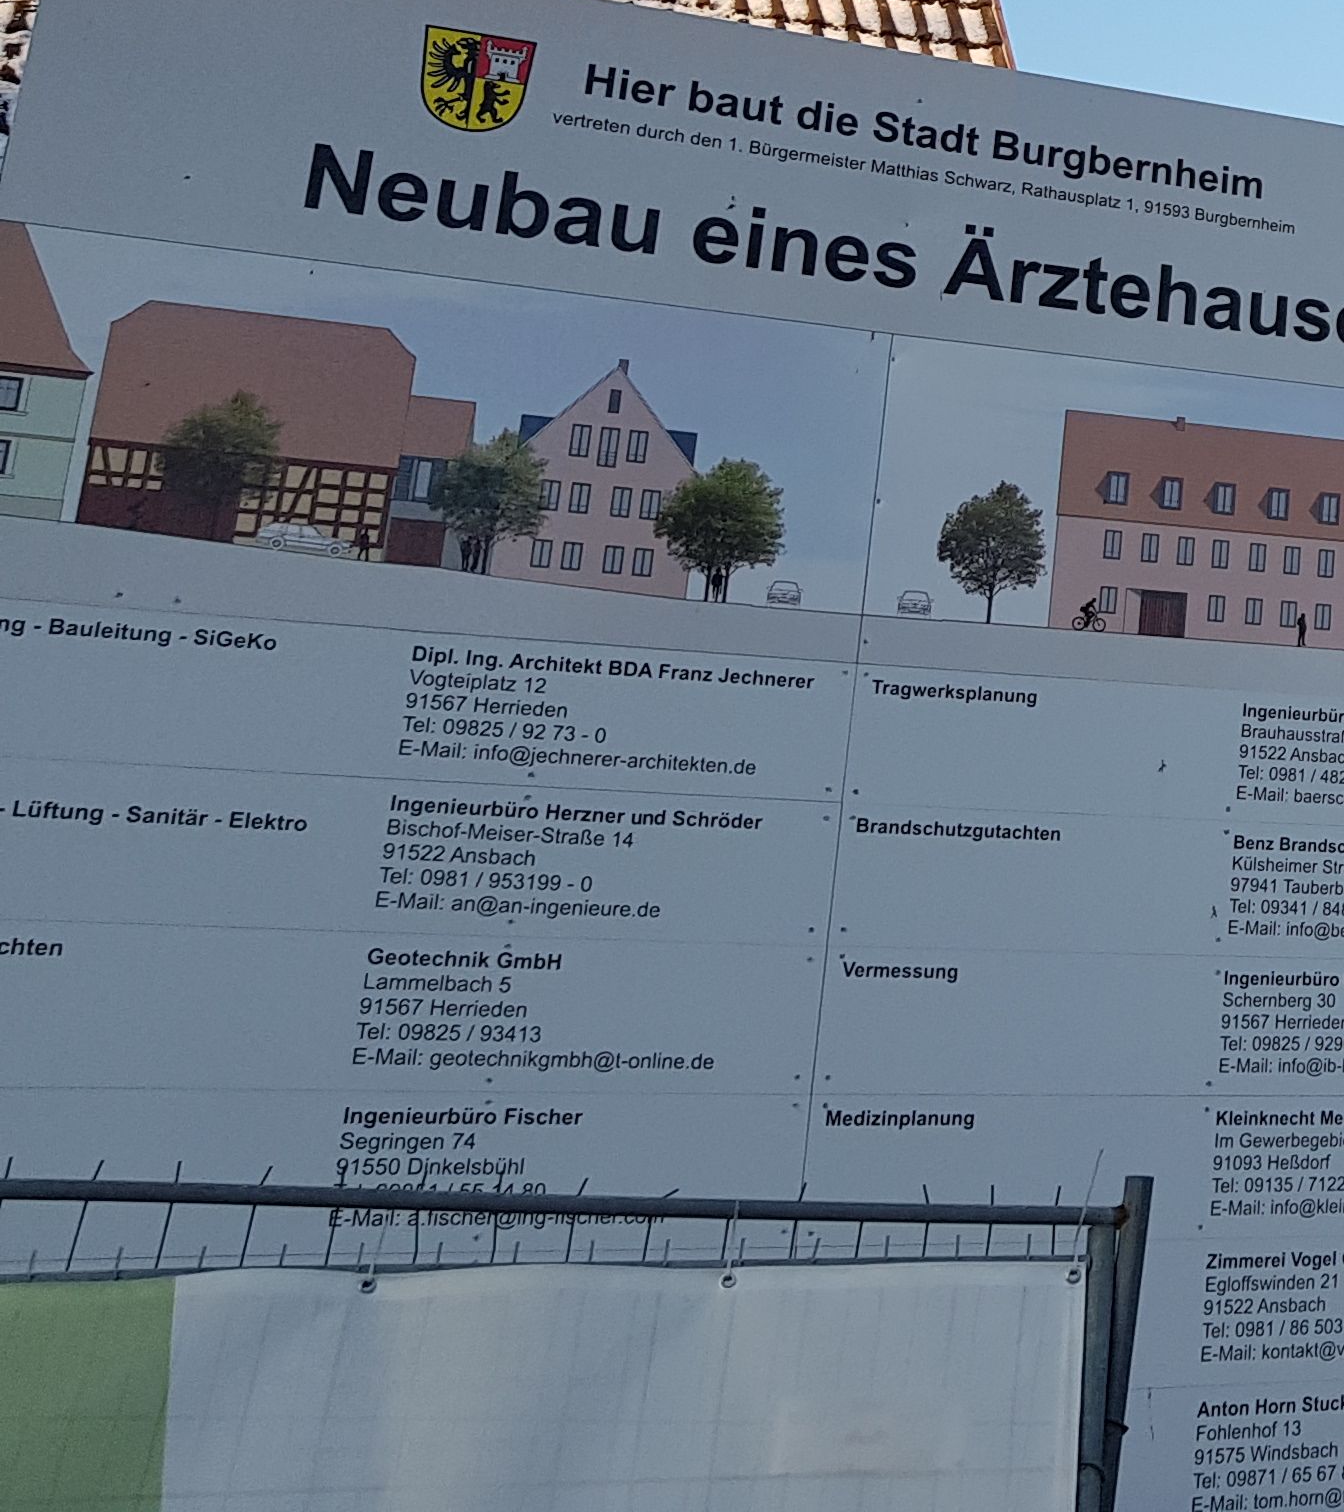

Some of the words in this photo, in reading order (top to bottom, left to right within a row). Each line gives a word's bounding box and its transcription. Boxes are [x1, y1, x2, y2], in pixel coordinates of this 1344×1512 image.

[585, 64, 676, 106] Hier
[688, 80, 783, 125] baut
[797, 101, 858, 136] die
[873, 112, 979, 156] Stadt
[992, 130, 1262, 199] Burgbernheim
[553, 113, 630, 135] vertreten
[637, 123, 684, 143] durch
[690, 132, 722, 149] den
[749, 140, 867, 170] Bürgermeister
[871, 159, 938, 182] Matthias
[945, 171, 1015, 195] Schwarz,
[1022, 182, 1121, 209] Rathausplatz
[1144, 200, 1189, 219] 91593
[1195, 208, 1295, 234] Burgbernheim
[304, 143, 660, 255] Neubau
[693, 207, 916, 288] eines
[48, 618, 172, 647] Bauleitung
[194, 629, 276, 650] SiGeKo
[412, 646, 458, 666] Dipl.
[466, 650, 503, 671] Ing.
[508, 654, 602, 674] Architekt
[609, 660, 653, 678] BDA
[658, 664, 713, 682] Franz
[718, 668, 815, 689] Jechnerer
[410, 669, 517, 693] Vogteiplatz
[524, 677, 546, 694] 12
[872, 679, 1037, 707] Tragwerksplanung
[406, 693, 468, 712] 91567
[474, 697, 567, 718] Herrieden
[398, 739, 467, 759] E-Mail:
[474, 744, 756, 775] info@jechnerer-architekten.de
[1240, 744, 1286, 760] 91522
[1238, 764, 1263, 780] Tel:
[1269, 767, 1304, 782] 0981
[1237, 785, 1288, 802] E-Mail:
[12, 800, 104, 825] Lüftung
[126, 806, 209, 826] Sanitär
[229, 811, 307, 831] Elektro
[390, 795, 538, 819] Ingenieurbüro
[546, 804, 626, 824] Herzner
[631, 810, 666, 825] und
[672, 810, 763, 829] Schröder
[387, 819, 605, 846] Bischof-Meiser-Straße
[613, 832, 633, 848] 14
[856, 818, 1060, 841] Brandschutzgutachten
[1234, 835, 1274, 850] Benz
[383, 843, 445, 862] 91522
[448, 847, 535, 866] Ansbach
[1232, 856, 1318, 873] Külsheimer
[380, 867, 413, 884] Tel:
[421, 869, 468, 887] 0981
[489, 872, 561, 891] 953199
[1231, 877, 1276, 893] 97941
[375, 891, 445, 910] E-Mail:
[451, 896, 660, 919] an@an-ingenieure.de
[1230, 898, 1255, 914] Tel:
[1261, 899, 1306, 915] 09341
[1228, 920, 1280, 936] E-Mail:
[368, 948, 490, 968] Geotechnik
[497, 952, 562, 970] GmbH
[364, 973, 492, 992] Lammelbach
[843, 961, 958, 983] Vermessung
[1224, 970, 1339, 989] Ingenieurbüro
[360, 997, 424, 1015] 91567
[430, 999, 527, 1018] Herrieden
[1223, 992, 1311, 1012] Schernberg
[1317, 993, 1335, 1008] 30
[1222, 1014, 1270, 1029] 91567
[356, 1022, 391, 1040] Tel:
[398, 1023, 461, 1041] 09825
[480, 1025, 541, 1043] 93413
[1220, 1036, 1246, 1051] Tel:
[1252, 1036, 1300, 1051] 09825
[352, 1047, 423, 1065] E-Mail:
[429, 1050, 714, 1072] geotechnikgmbh@t-online.de
[1219, 1058, 1272, 1073] E-Mail:
[343, 1107, 496, 1129] Ingenieurbüro
[504, 1108, 583, 1125] Fischer
[826, 1110, 974, 1130] Medizinplanung
[1216, 1110, 1315, 1126] Kleinknecht
[340, 1132, 444, 1154] Segringen
[453, 1133, 475, 1150] 74
[1215, 1133, 1233, 1148] Im
[1213, 1155, 1262, 1171] 91093
[1268, 1154, 1331, 1170] Heßdorf
[1210, 1200, 1265, 1216] E-Mail:
[1206, 1252, 1286, 1269] Zimmerei
[1291, 1251, 1336, 1270] Vogel
[1206, 1274, 1315, 1296] Egloffswinden
[1320, 1273, 1337, 1289] 21
[1204, 1298, 1253, 1315] 91522
[1257, 1296, 1325, 1314] Ansbach
[1202, 1322, 1229, 1339] Tel:
[1235, 1320, 1273, 1338] 0981
[1290, 1319, 1309, 1335] 86
[1314, 1318, 1343, 1335] 503
[1201, 1344, 1256, 1362] E-Mail:
[1197, 1401, 1249, 1418] Anton
[1255, 1398, 1296, 1415] Horn
[1196, 1421, 1278, 1442] Fohlenhof
[1283, 1420, 1301, 1437] 13
[1195, 1447, 1245, 1465] 91575
[1250, 1441, 1338, 1462] Windsbach
